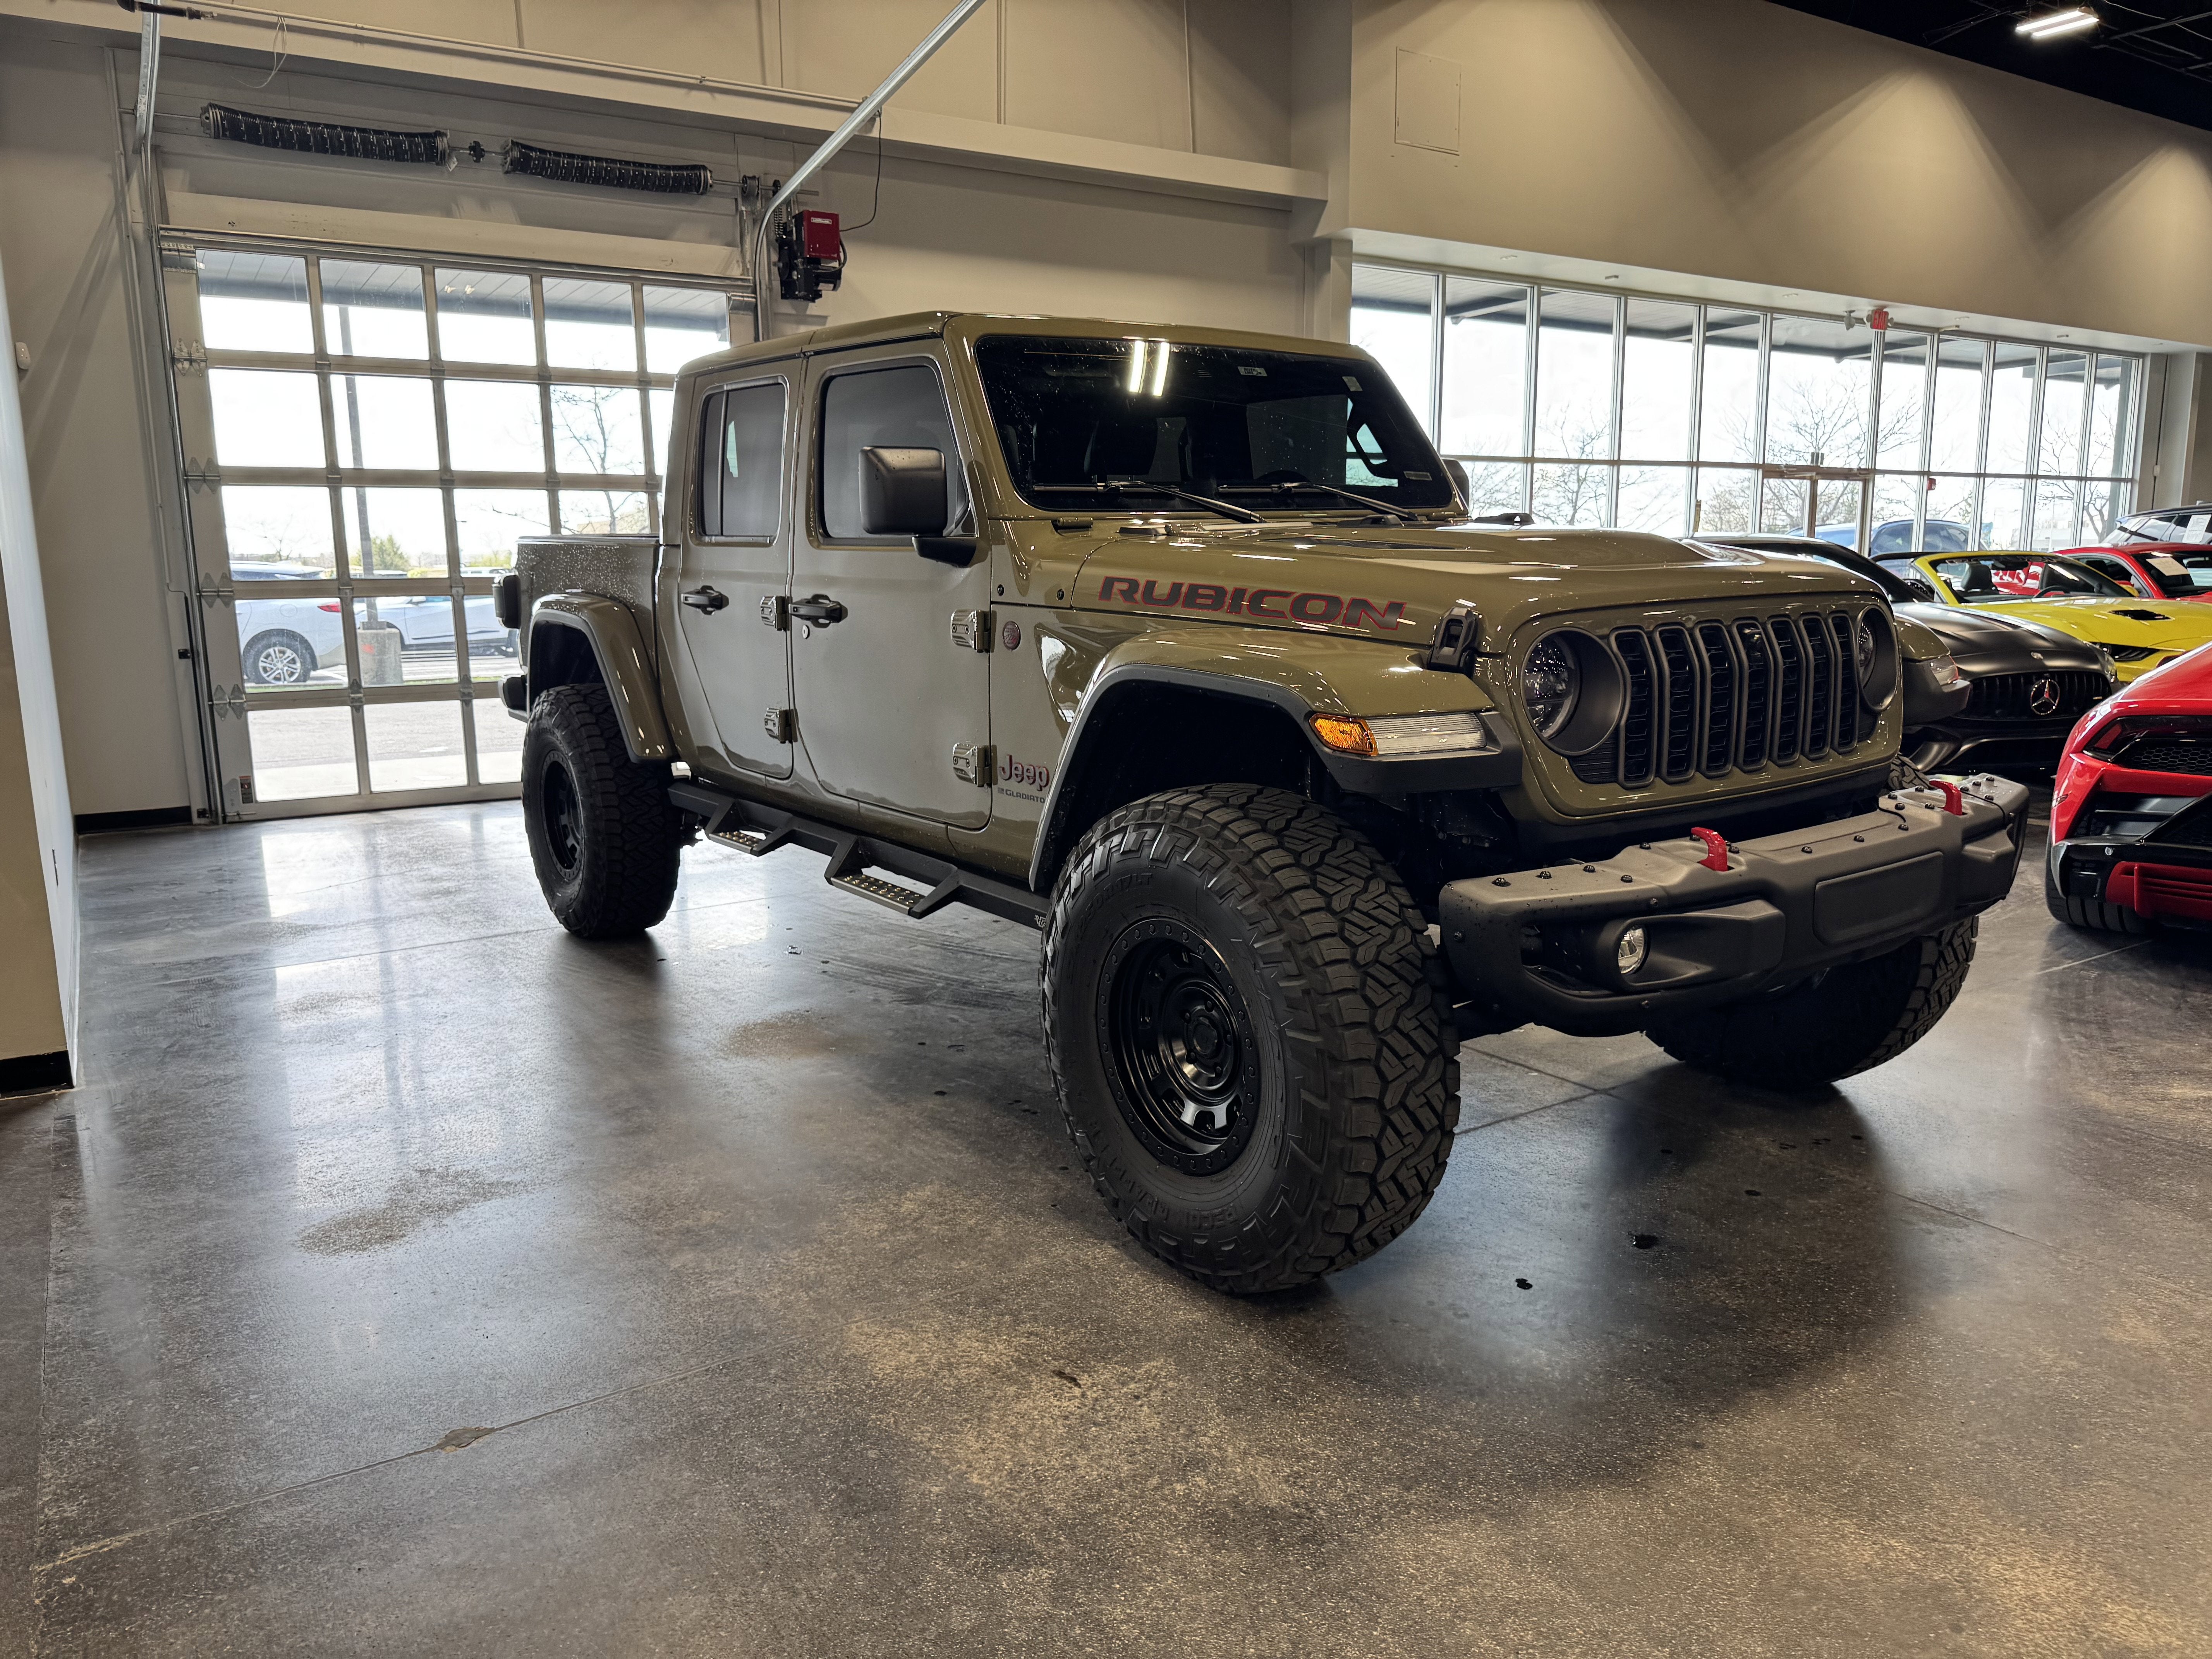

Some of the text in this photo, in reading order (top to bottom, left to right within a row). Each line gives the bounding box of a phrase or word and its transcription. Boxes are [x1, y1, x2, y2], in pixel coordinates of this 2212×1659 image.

[1098, 576, 1407, 630] RUBICON
[999, 754, 1050, 792] Jeep
[1005, 789, 1045, 804] GLADIATO
